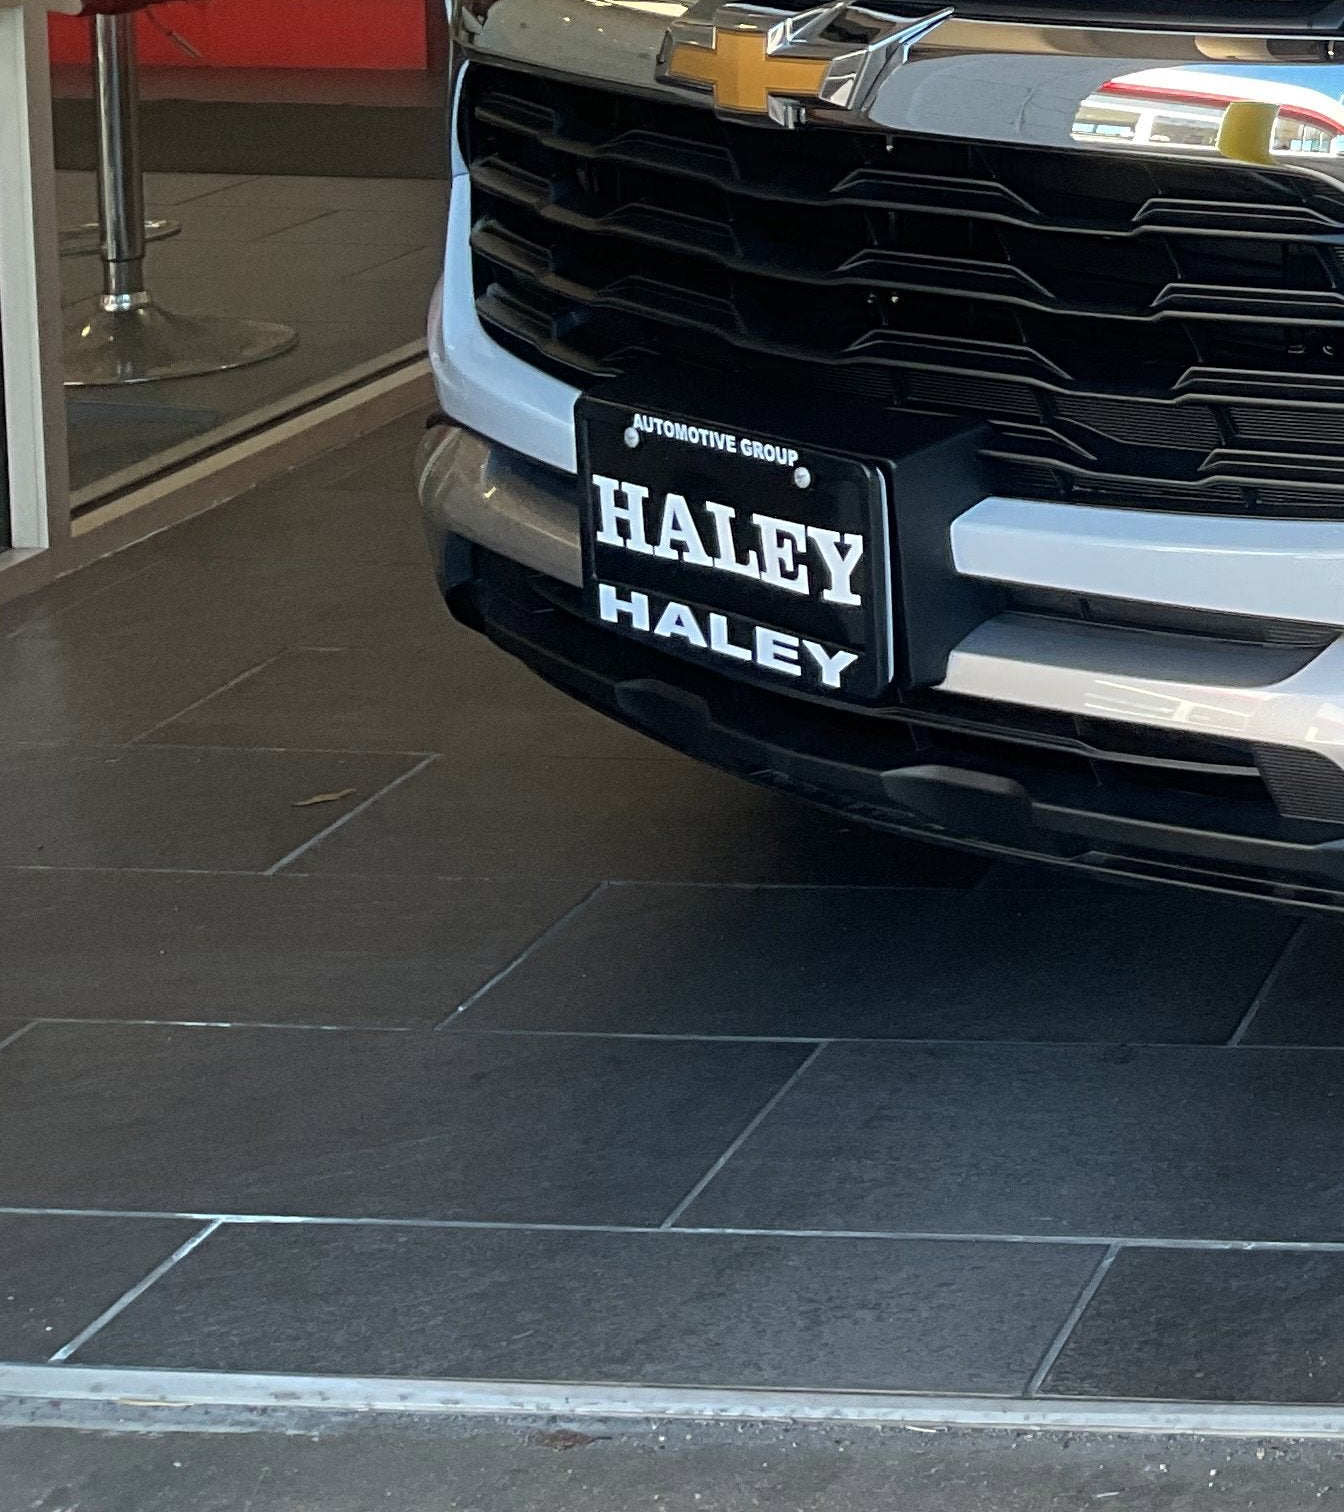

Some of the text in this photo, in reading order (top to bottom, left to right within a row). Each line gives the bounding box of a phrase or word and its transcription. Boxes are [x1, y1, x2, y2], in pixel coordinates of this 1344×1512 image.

[633, 413, 799, 467] AUTOMOTIVE GROUP
[592, 473, 864, 607] HALEY
[598, 583, 859, 689] HALEY
